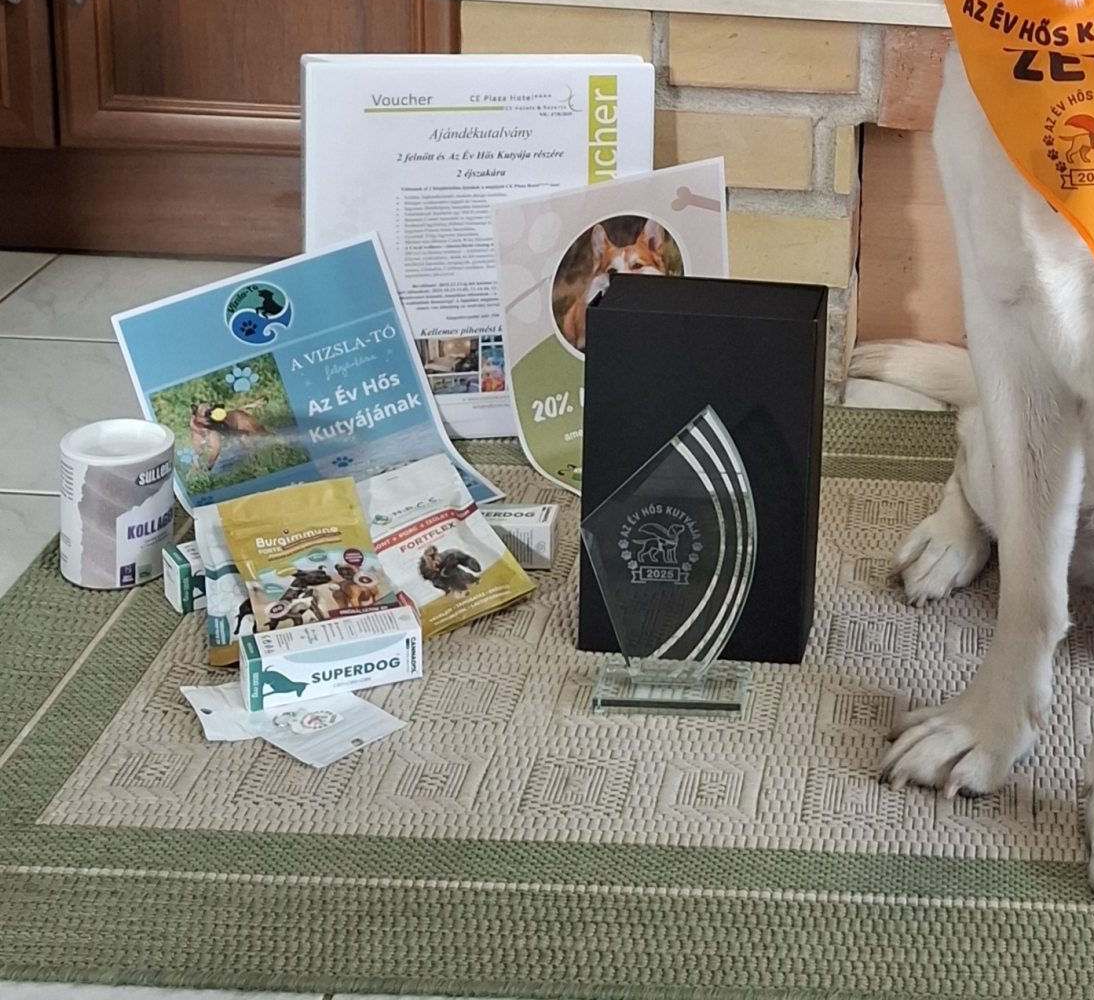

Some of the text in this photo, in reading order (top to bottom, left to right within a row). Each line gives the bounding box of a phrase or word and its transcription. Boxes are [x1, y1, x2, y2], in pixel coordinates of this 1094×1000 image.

[989, 1, 1019, 34] ÉV
[1019, 18, 1069, 46] HŐS
[371, 94, 433, 107] Voucher
[484, 94, 507, 102] Plaza
[1050, 101, 1066, 117] ÉV
[428, 126, 533, 141] Ajándékutalvány
[594, 87, 618, 181] ucher
[1044, 117, 1057, 133] AZ
[396, 153, 402, 162] 2
[436, 152, 445, 161] és
[449, 152, 460, 161] Az
[497, 150, 531, 162] Kutyája
[532, 149, 564, 159] részére
[456, 168, 506, 179] 2 éjszakára
[420, 327, 459, 336] Kellemes
[460, 326, 495, 336] pihenést
[290, 324, 396, 372] A VIZSLA-TÓ
[308, 373, 400, 417] Az Év Hős
[531, 391, 574, 422] 20%
[308, 392, 422, 444] Kutyájának
[620, 524, 632, 538] AZ
[665, 505, 701, 540] KUTYÁJA
[255, 525, 339, 549] Burgimmune
[399, 521, 457, 553] FORTFLEX
[646, 569, 674, 578] 2025
[311, 657, 401, 684] SUPERDOG
